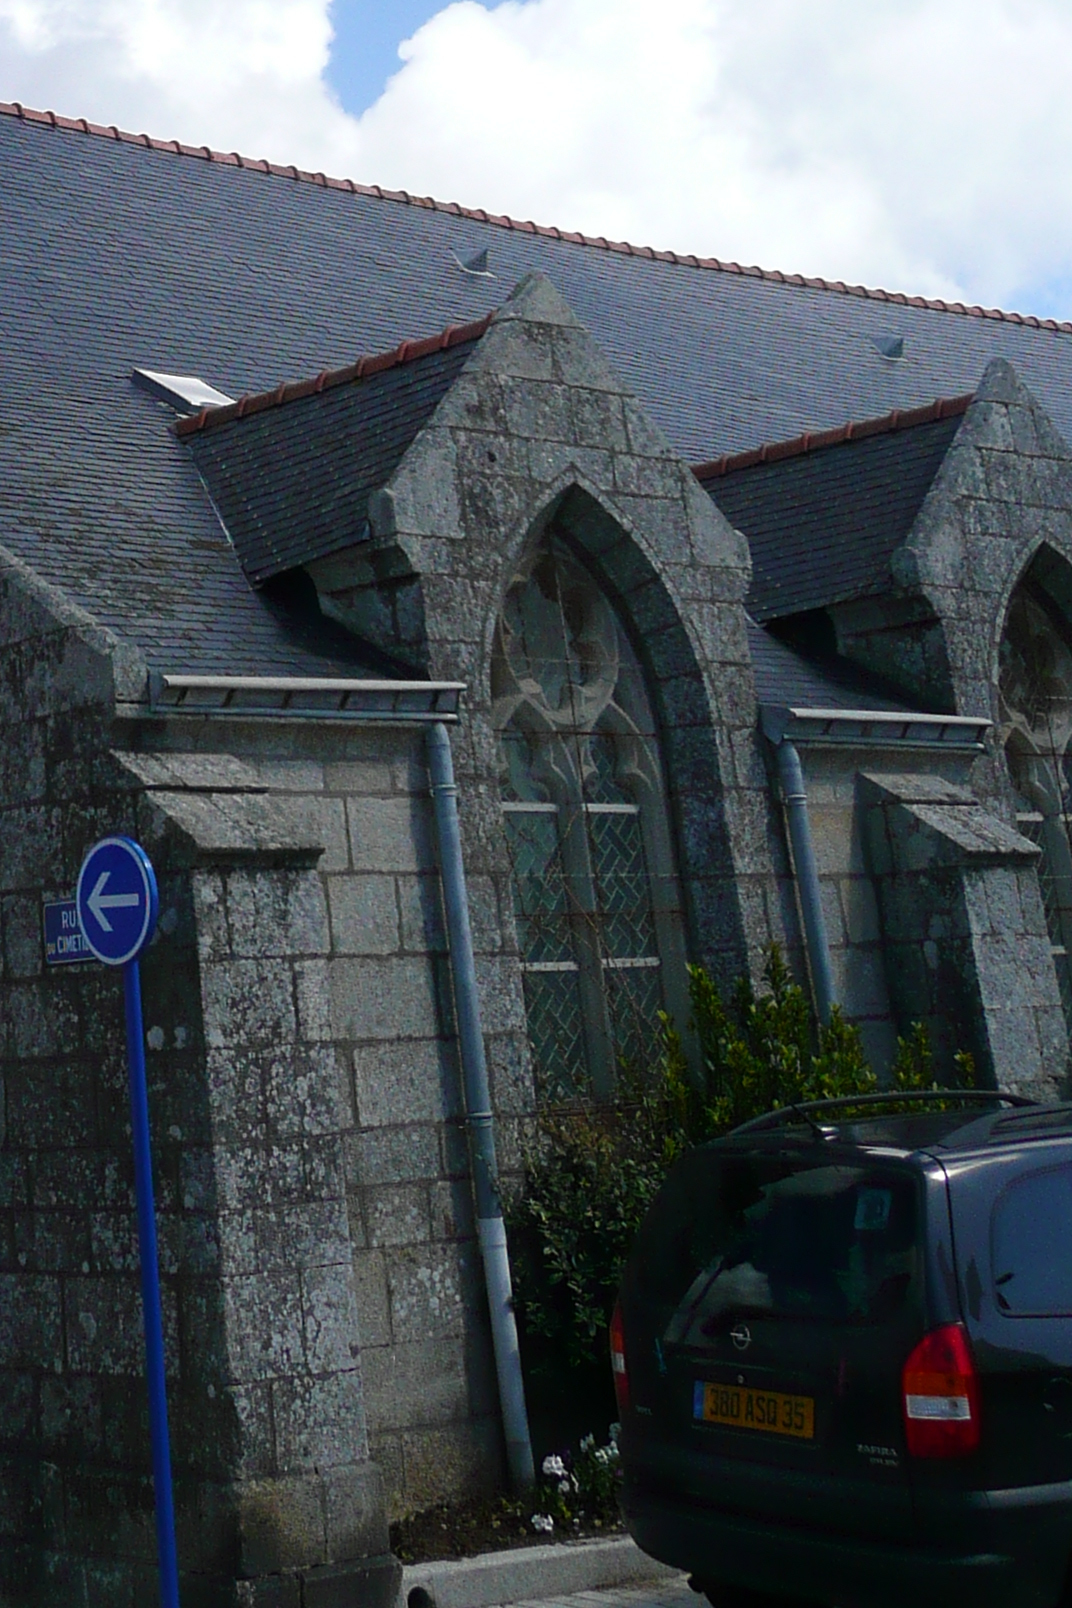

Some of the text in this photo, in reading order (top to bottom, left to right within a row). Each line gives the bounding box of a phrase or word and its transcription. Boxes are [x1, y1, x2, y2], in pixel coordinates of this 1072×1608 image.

[709, 1388, 805, 1430] 380 ASQ 35
